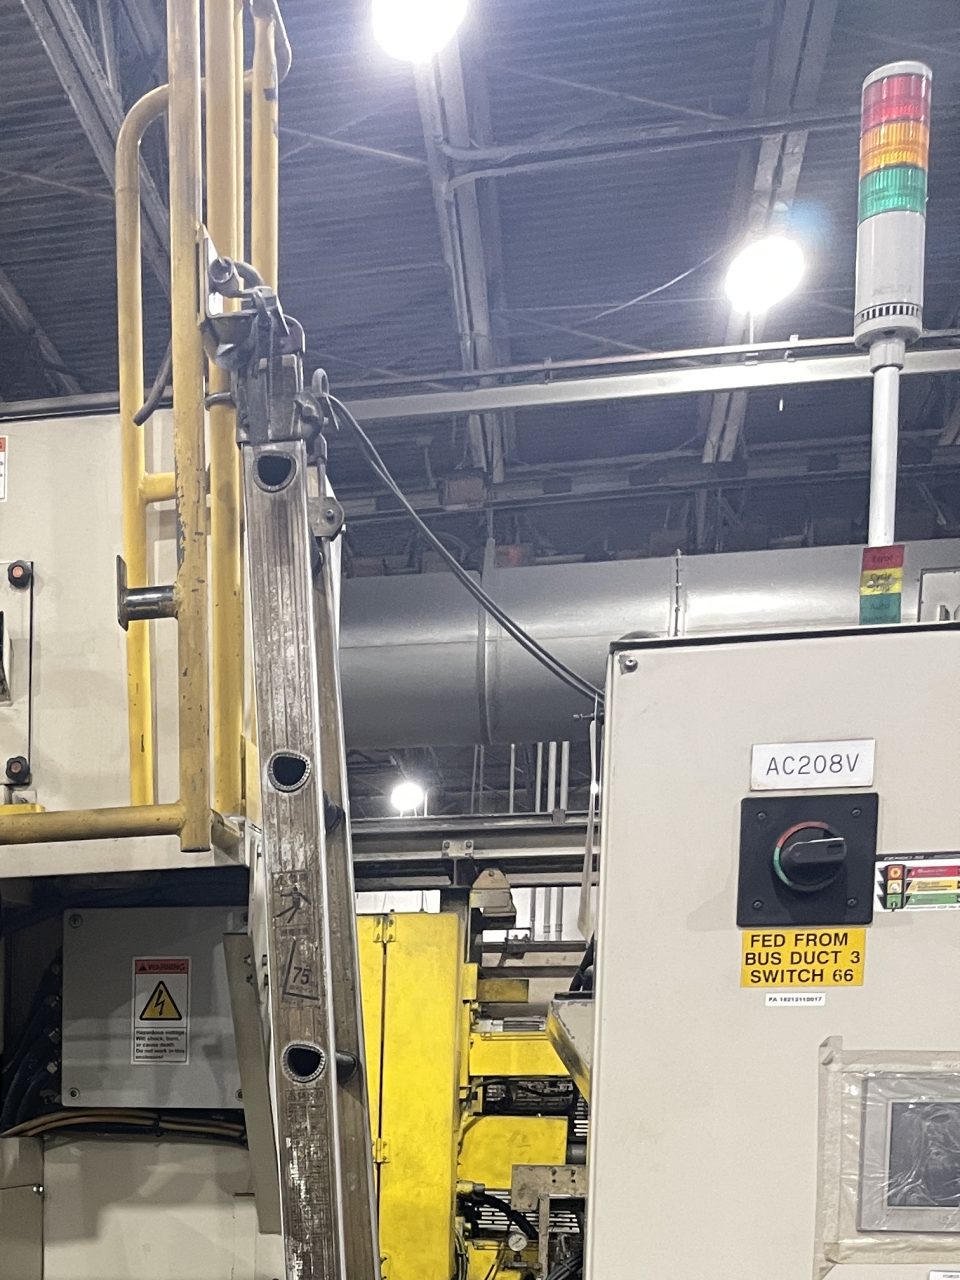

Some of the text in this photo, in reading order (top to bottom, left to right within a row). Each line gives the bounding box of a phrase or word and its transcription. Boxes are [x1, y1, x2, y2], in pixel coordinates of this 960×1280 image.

[766, 753, 860, 776] AC208V
[751, 932, 848, 948] FED FROM
[745, 950, 861, 965] BUS DUCT 3
[750, 968, 854, 983] SWITCH 66
